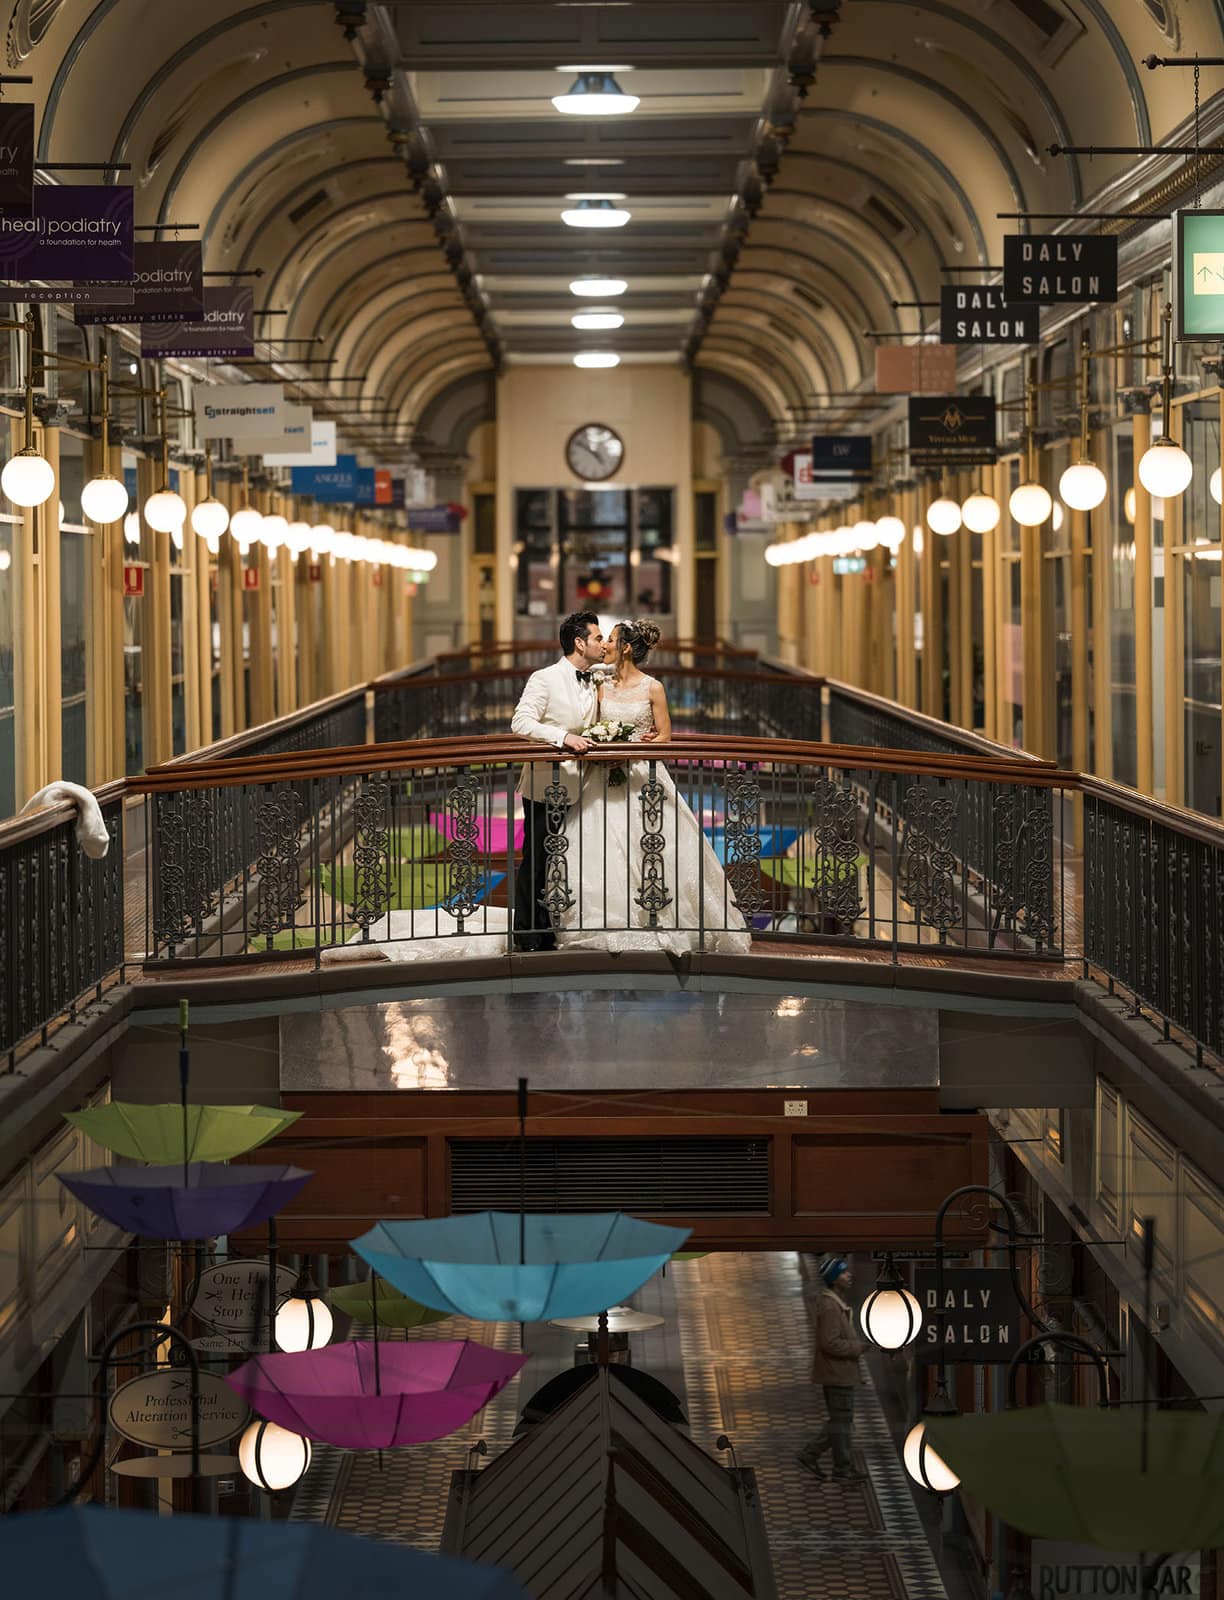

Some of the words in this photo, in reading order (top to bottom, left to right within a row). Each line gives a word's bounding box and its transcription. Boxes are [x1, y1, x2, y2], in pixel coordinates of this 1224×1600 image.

[46, 239, 87, 247] foundation
[87, 239, 97, 247] for
[98, 239, 122, 247] health
[1022, 242, 1083, 262] DALY
[1022, 276, 1100, 295] SALON
[24, 292, 91, 300] reception
[956, 291, 1008, 310] DALY
[956, 320, 1025, 338] SALON
[212, 1272, 241, 1285] One
[248, 1271, 281, 1285] Hr
[926, 1288, 992, 1309] DALY
[212, 1304, 243, 1320] Stop
[199, 1336, 225, 1348] Same
[926, 1324, 1010, 1344] SALON
[145, 1393, 218, 1407] Professinal
[126, 1410, 188, 1423] Alteration
